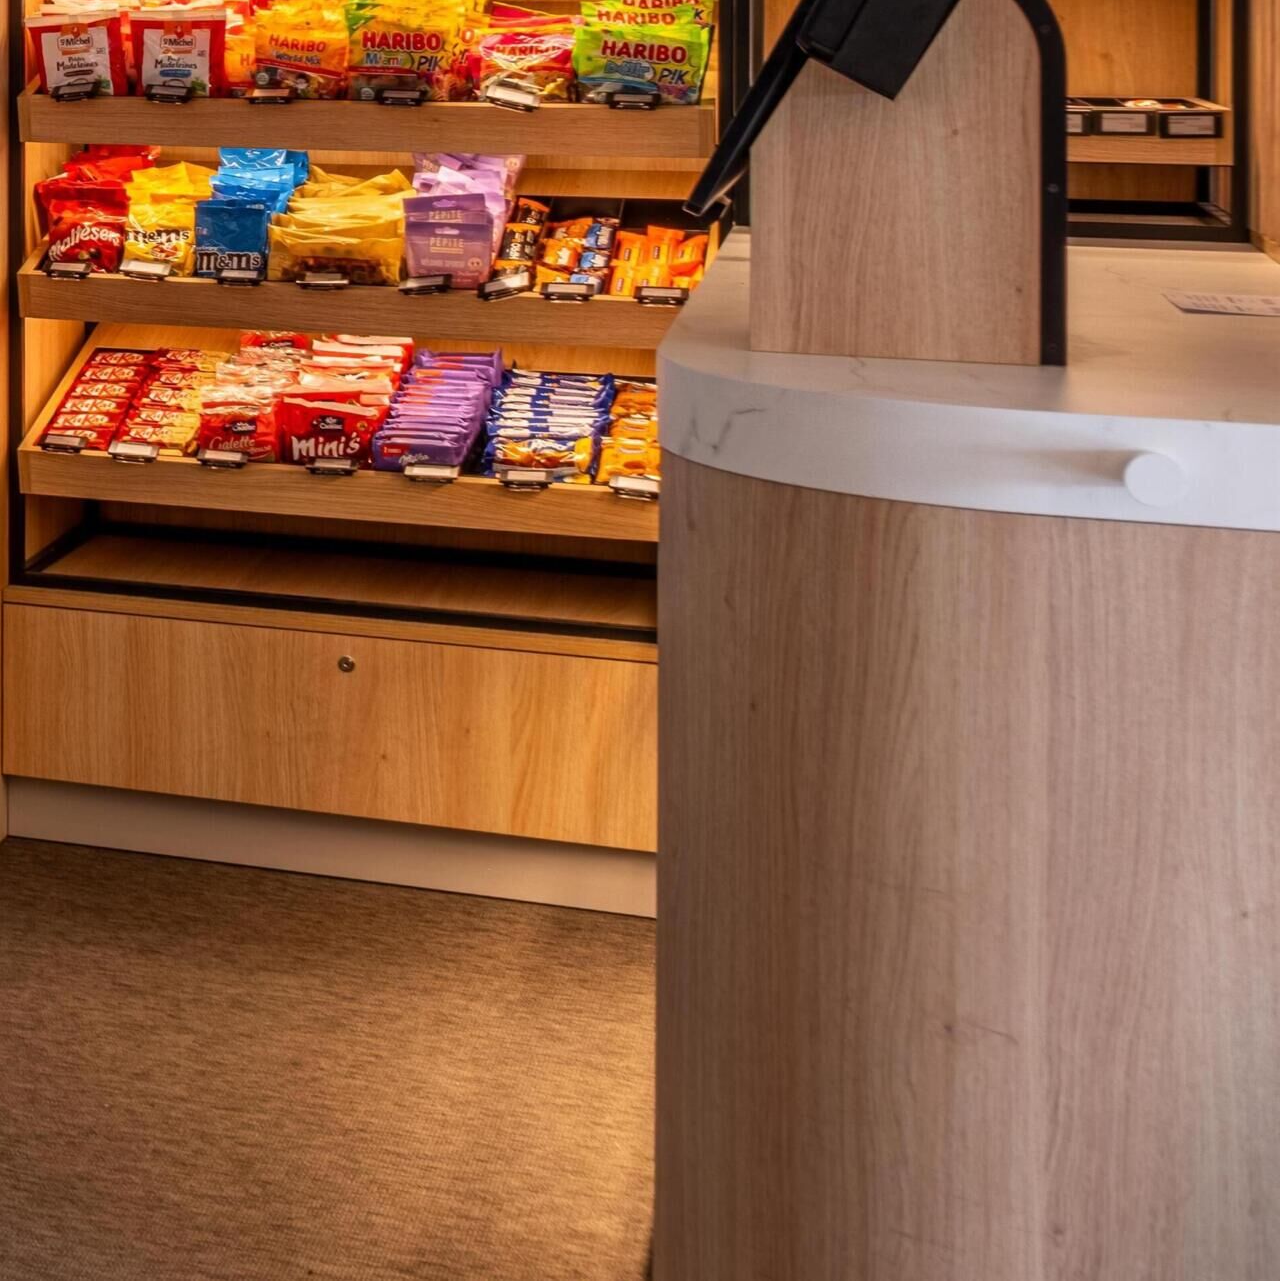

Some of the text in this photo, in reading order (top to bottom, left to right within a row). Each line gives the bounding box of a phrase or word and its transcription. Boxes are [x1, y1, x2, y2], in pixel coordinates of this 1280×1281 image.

[597, 9, 676, 26] HARIBO
[66, 37, 91, 46] Michel
[168, 38, 194, 47] Michel
[269, 34, 327, 53] HARIBO
[362, 31, 441, 52] HARIBO
[601, 40, 688, 64] HARIBO
[49, 221, 121, 262] Maltesers
[292, 432, 360, 461] Mini's
